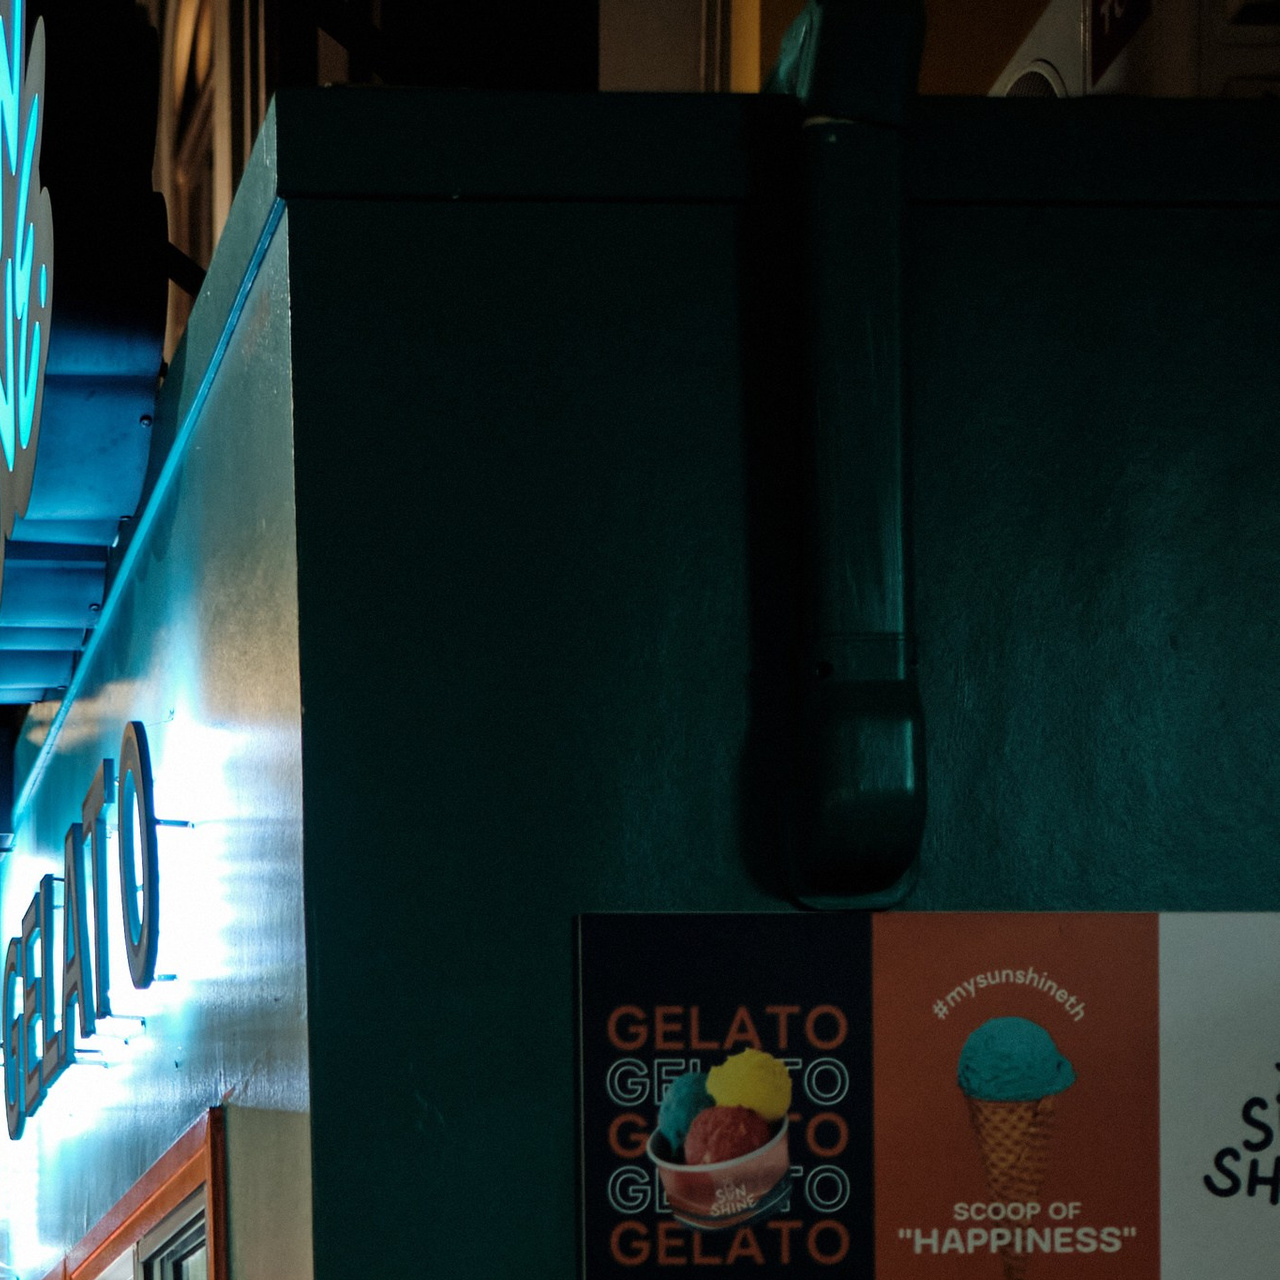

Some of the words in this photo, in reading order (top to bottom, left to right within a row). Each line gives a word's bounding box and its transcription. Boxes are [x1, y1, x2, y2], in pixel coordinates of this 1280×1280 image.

[2, 720, 162, 1140] GELATO
[931, 966, 1086, 1023] #mysunshineth
[606, 1003, 849, 1051] GELATO
[952, 1201, 1042, 1222] SCOOP
[1048, 1201, 1083, 1221] OF
[609, 1218, 852, 1266] GELATO
[897, 1226, 1137, 1255] "HAPPINESS"
